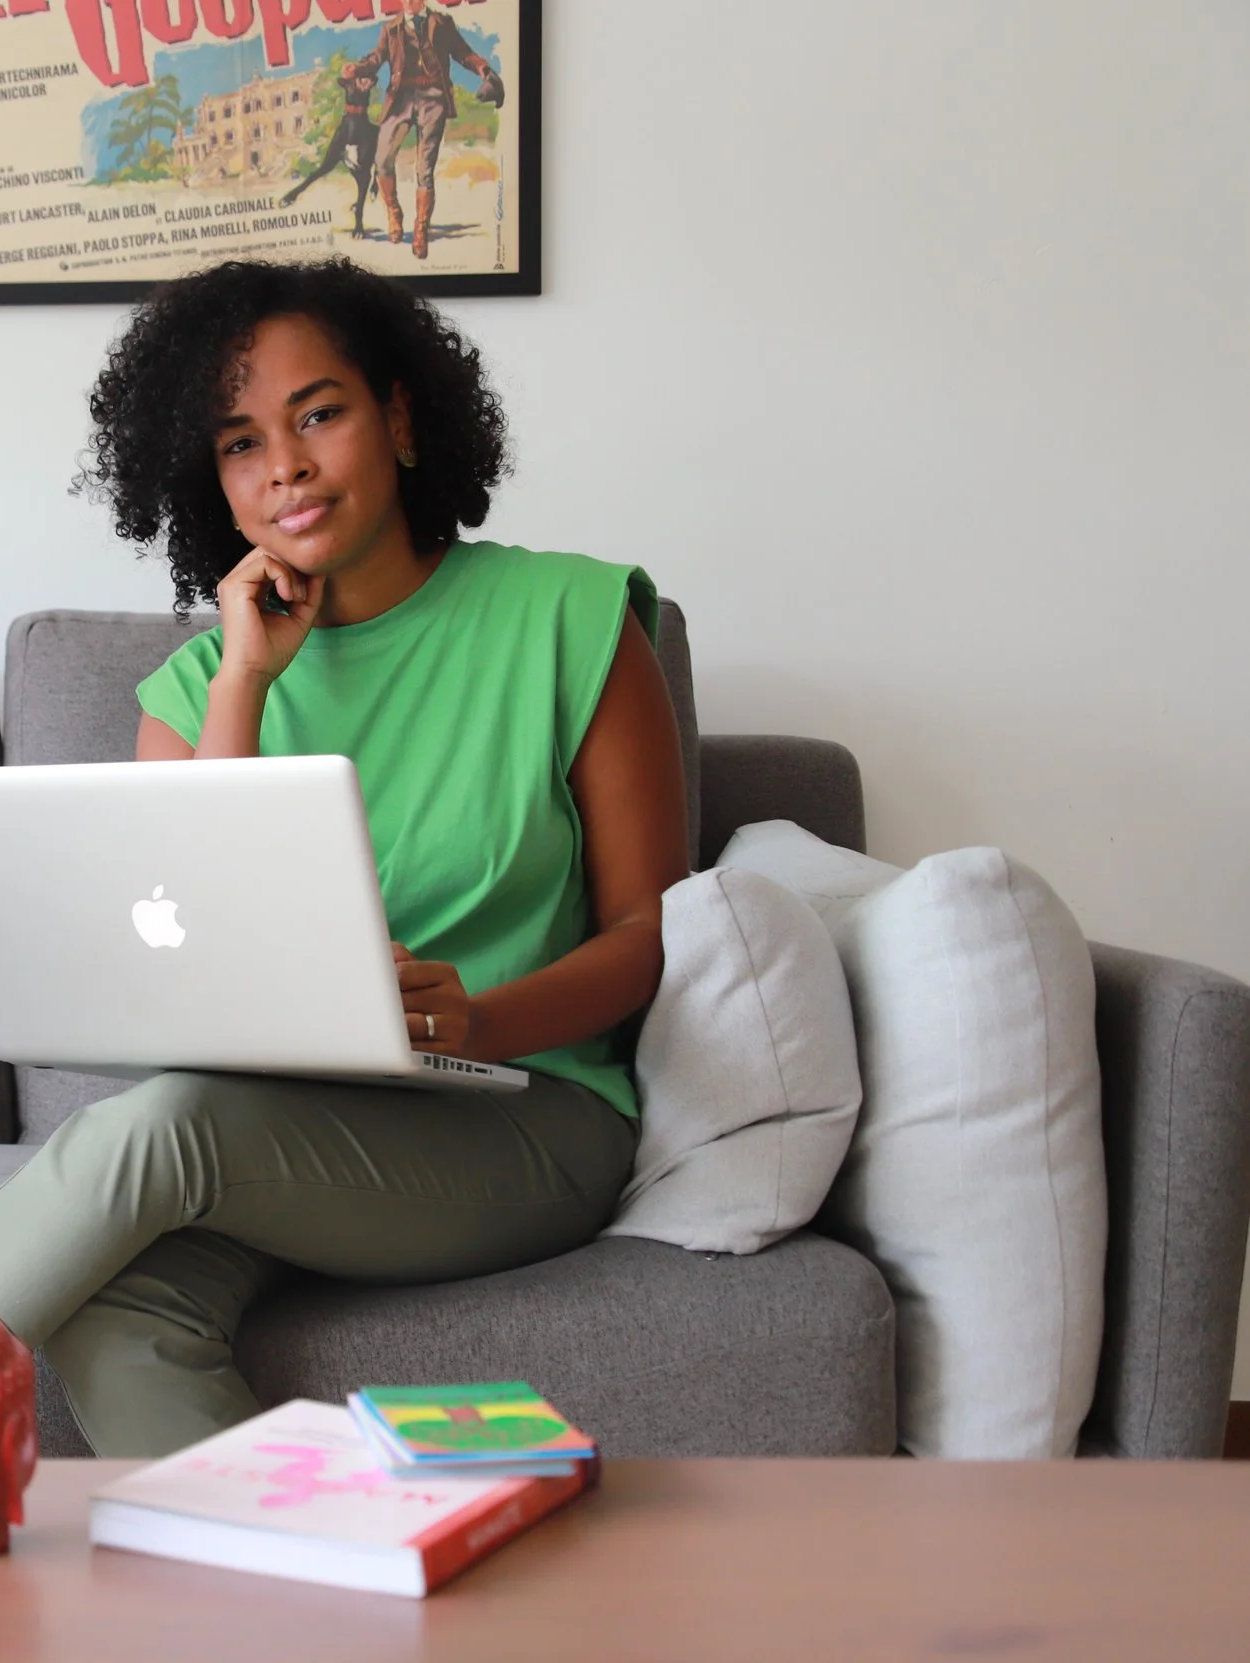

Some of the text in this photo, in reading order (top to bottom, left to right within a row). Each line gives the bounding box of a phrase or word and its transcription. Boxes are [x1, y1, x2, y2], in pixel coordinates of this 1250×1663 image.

[32, 167, 84, 184] VISCONTI
[19, 202, 86, 221] LANCASTER,
[87, 208, 121, 223] ALAIN
[124, 203, 157, 218] DELON
[164, 206, 212, 223] CLAUDIA
[214, 197, 275, 217] CARDINALE
[27, 243, 82, 260] REGGIANI,
[83, 237, 119, 253] PAOLO
[121, 231, 169, 249] STOPPA,
[171, 230, 199, 243] RINA
[200, 222, 250, 240] MORELLI,
[253, 217, 298, 232] ROMOLO
[300, 210, 332, 226] VALLI
